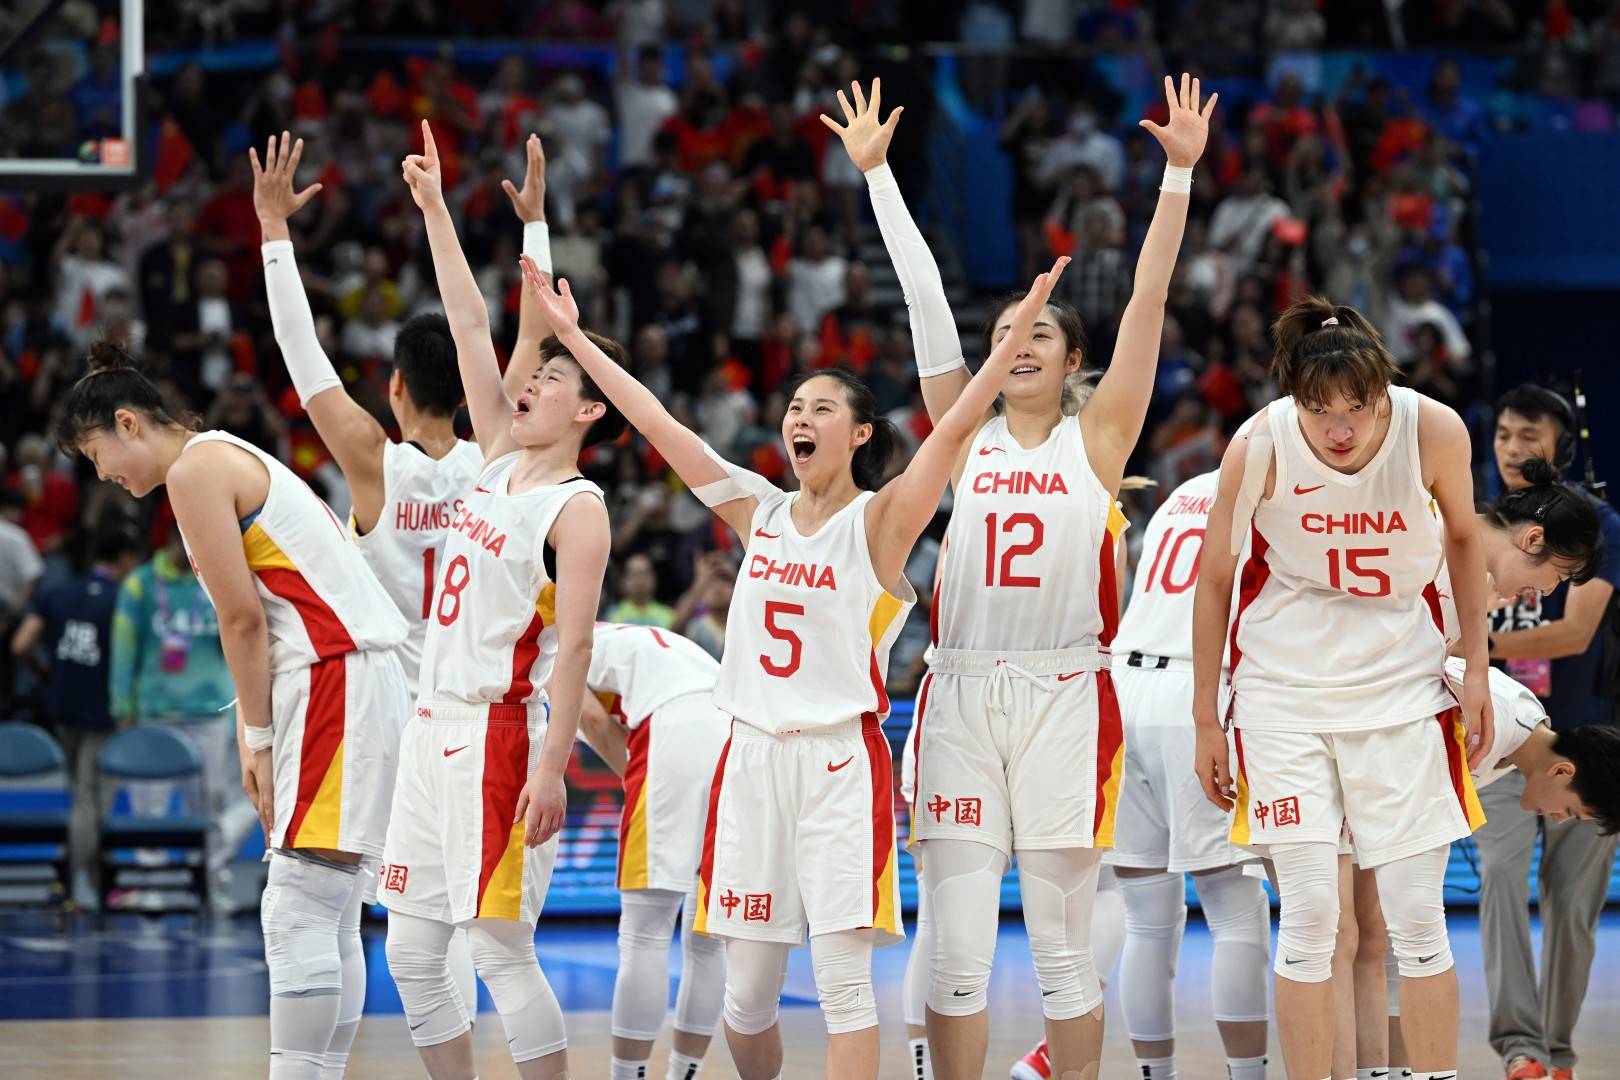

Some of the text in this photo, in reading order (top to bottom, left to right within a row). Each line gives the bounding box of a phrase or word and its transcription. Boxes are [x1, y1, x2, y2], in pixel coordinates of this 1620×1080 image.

[973, 471, 1069, 495] CHINA
[396, 502, 450, 531] HUANG
[1167, 495, 1213, 515] ZHAN
[452, 509, 507, 557] CHINA
[1301, 511, 1408, 535] CHINA
[985, 512, 1044, 587] 12
[1145, 527, 1207, 594] 10
[750, 554, 837, 591] CHINA
[1326, 547, 1391, 597] 15
[437, 554, 470, 627] 8
[759, 600, 805, 678] 5
[928, 794, 982, 827] 中国
[1254, 795, 1300, 830] 中国
[380, 864, 408, 894] 国
[720, 889, 772, 922] 中国
